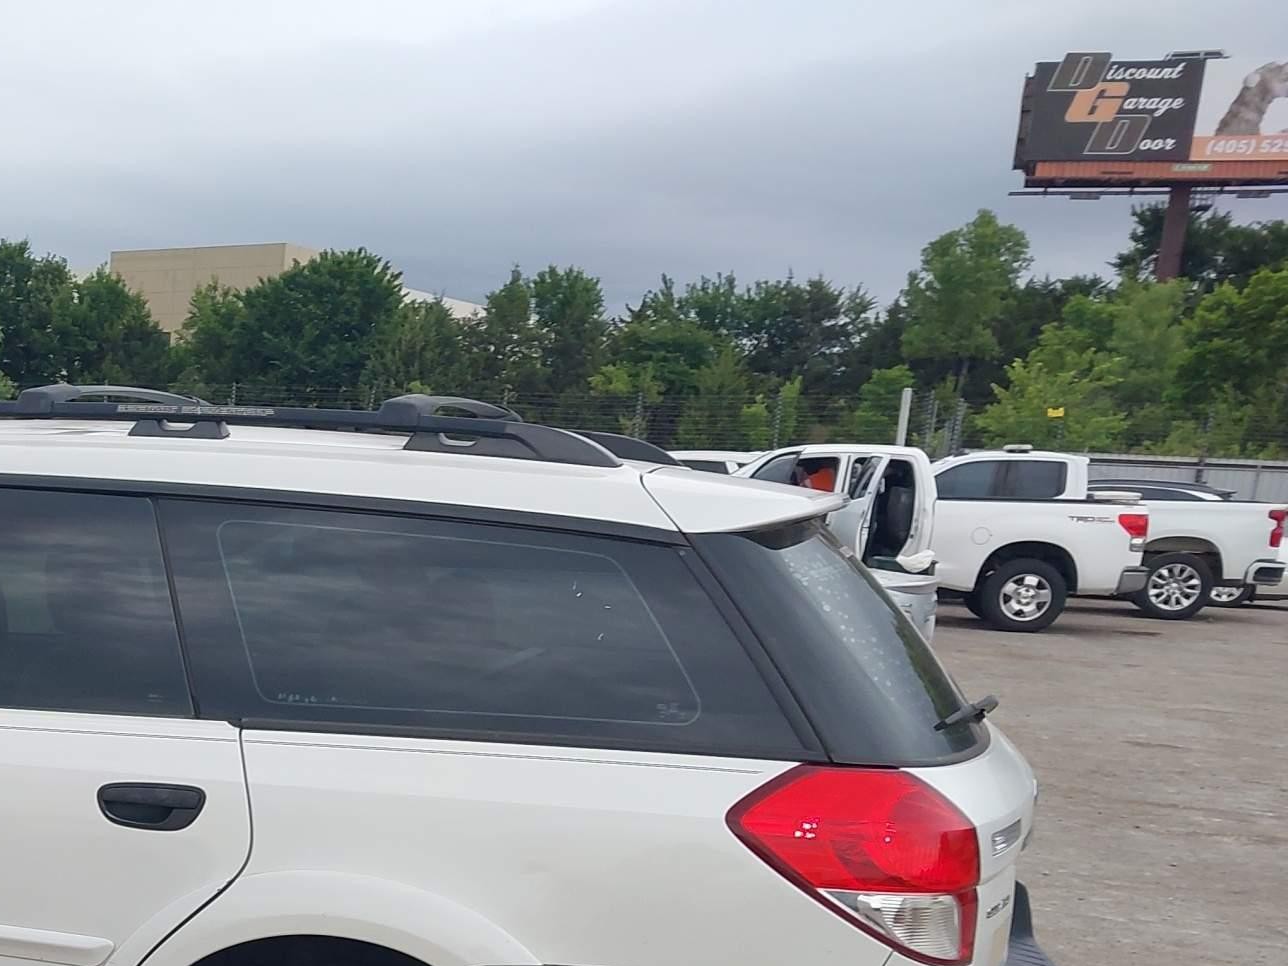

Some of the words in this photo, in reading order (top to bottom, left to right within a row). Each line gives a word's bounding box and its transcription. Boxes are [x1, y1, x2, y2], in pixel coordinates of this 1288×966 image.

[1046, 51, 1187, 92] Discount
[1064, 81, 1185, 123] Garage
[1083, 114, 1176, 154] Door
[1206, 138, 1257, 155] (405)
